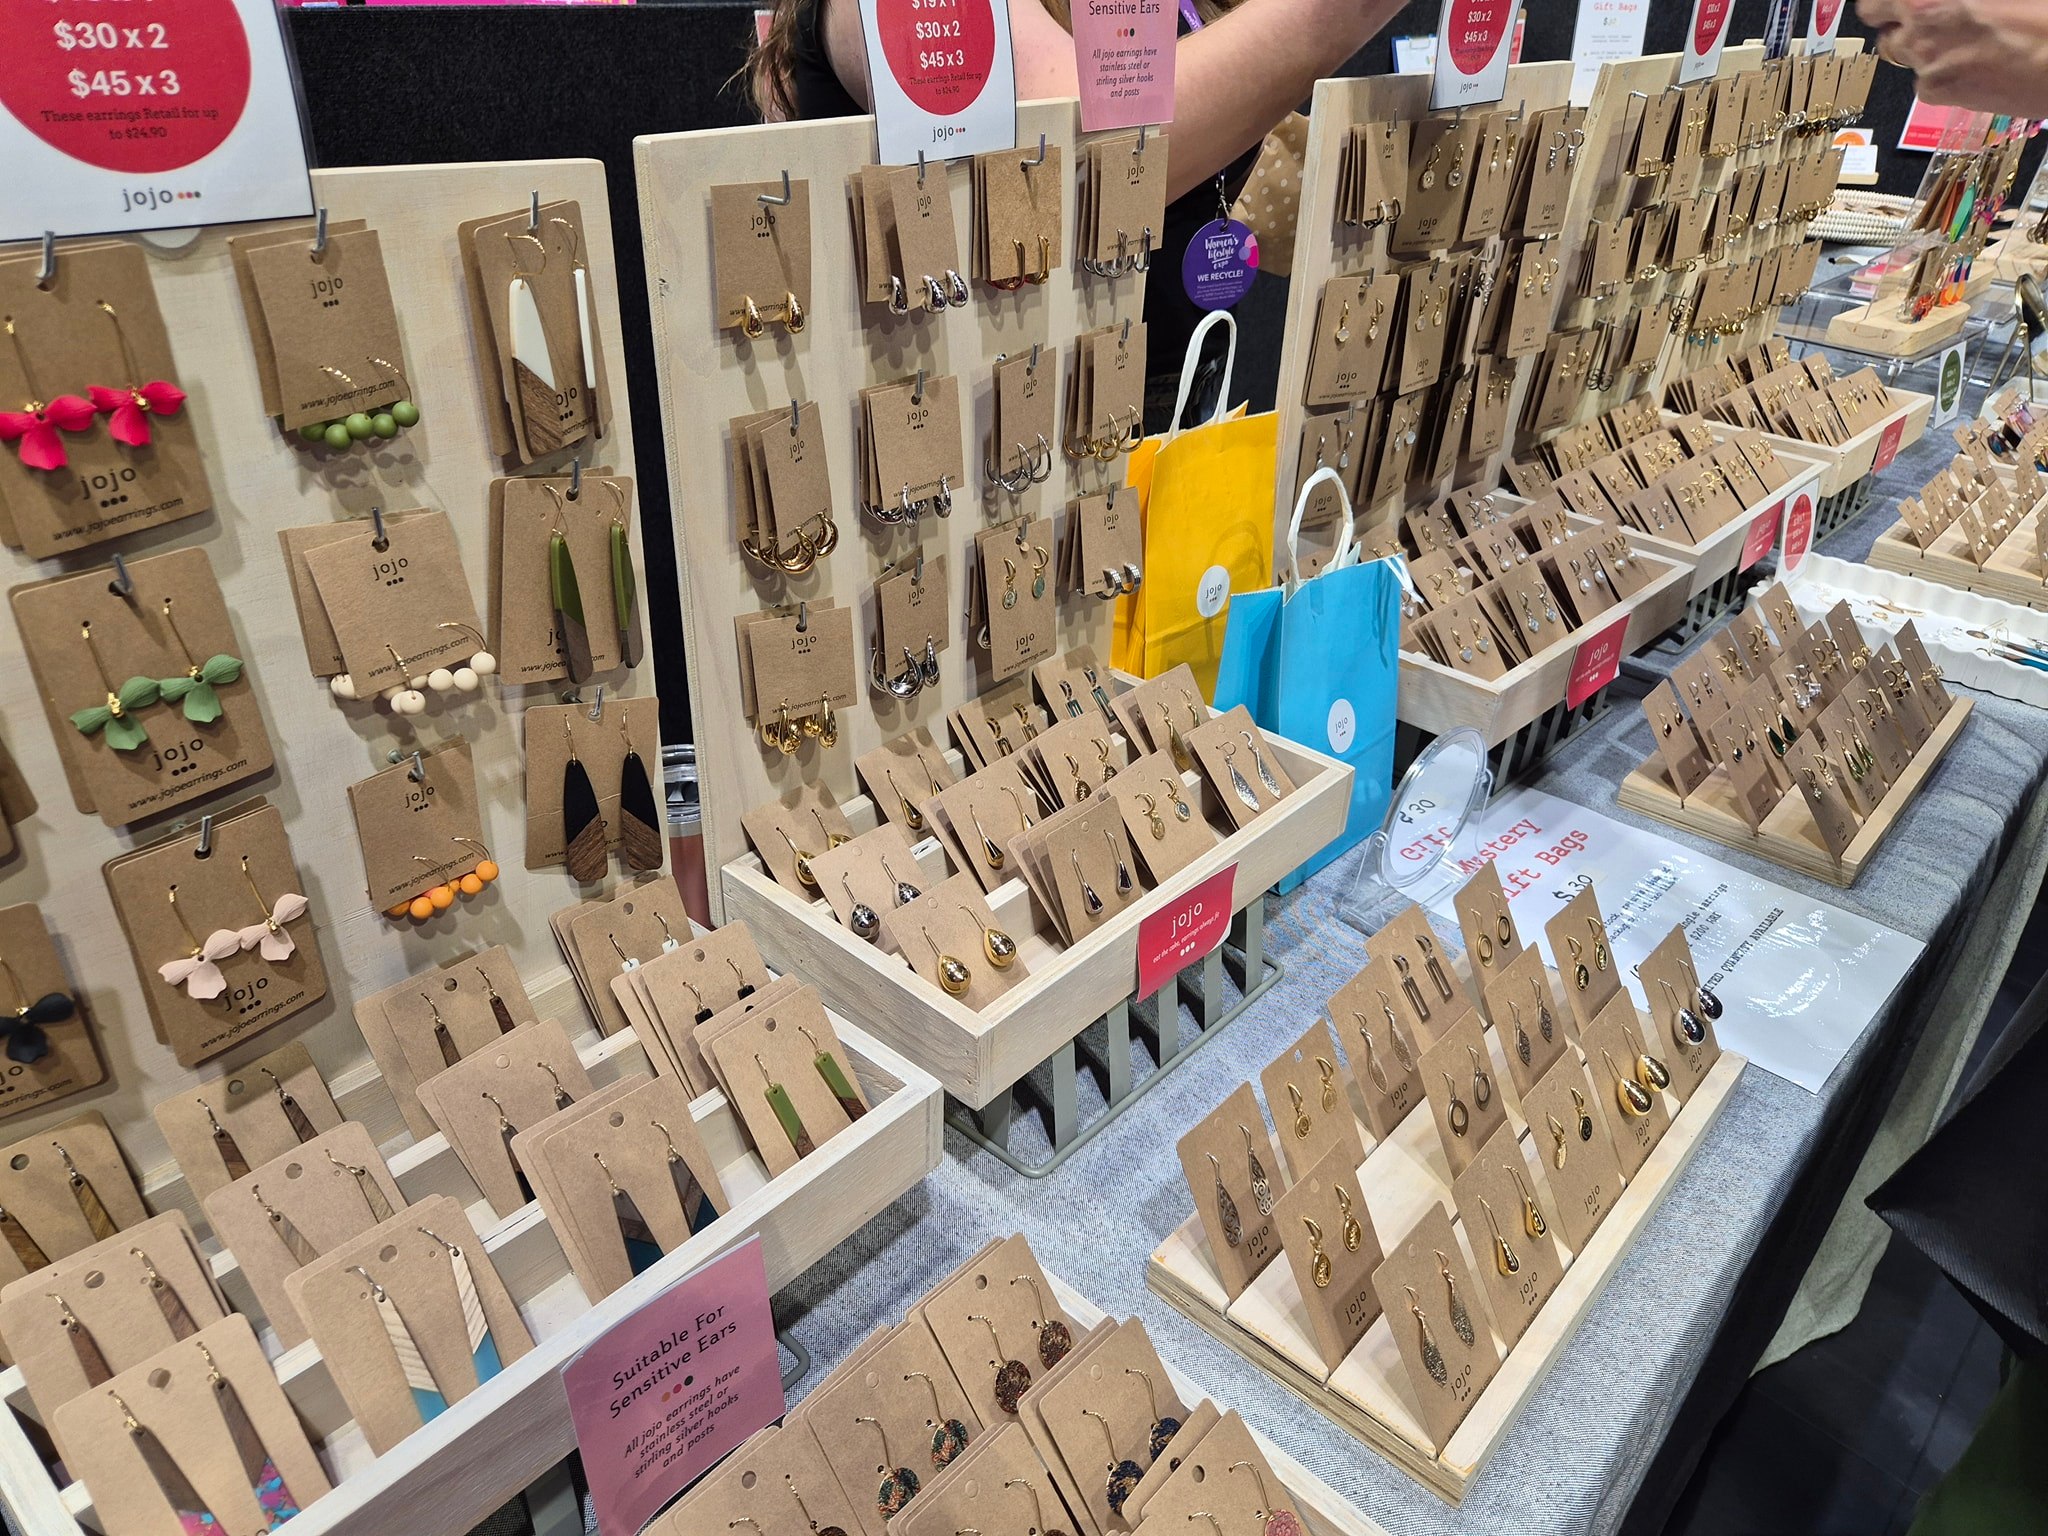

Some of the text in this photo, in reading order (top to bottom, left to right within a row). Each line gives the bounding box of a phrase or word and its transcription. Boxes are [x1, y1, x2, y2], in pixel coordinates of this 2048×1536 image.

[1088, 0, 1160, 15] Sensitive Ears
[1467, 11, 1481, 24] $30
[1486, 10, 1492, 21] 2
[53, 19, 169, 50] $30 x 2
[915, 20, 961, 40] $30 x 2
[1463, 31, 1477, 44] $45
[1482, 30, 1488, 41] 3
[919, 49, 964, 70] $45 x 3
[1092, 46, 1158, 61] All jojo earrings have
[1099, 60, 1150, 72] stainless steel or
[67, 68, 181, 99] $45 x 3
[1095, 71, 1154, 87] stirling silver hooks
[1459, 82, 1473, 94] jojo
[1110, 88, 1140, 99] and posts
[41, 108, 219, 122] These earrings Retail for up
[109, 127, 167, 140] to $24.90
[932, 125, 954, 142] jojo
[1127, 165, 1145, 179] jojo
[122, 188, 174, 212] jojo
[916, 195, 932, 211] jojo
[1541, 203, 1556, 215] jojo
[751, 214, 776, 230] jojo
[1418, 218, 1438, 230] jojo
[1204, 234, 1239, 250] Women's
[1212, 260, 1229, 270] expo
[1197, 269, 1244, 283] WE RECYCLE!
[310, 276, 343, 299] jojo
[1115, 352, 1129, 366] jojo
[1415, 358, 1429, 369] jojo
[1022, 378, 1038, 394] jojo
[1336, 371, 1357, 384] jojo
[301, 378, 395, 411] www.jojoearrings.com
[554, 386, 579, 409] ojo
[907, 409, 929, 425] jojo
[789, 440, 805, 458] jojo
[80, 466, 137, 499] jojo
[1313, 495, 1333, 508] jojo
[53, 496, 184, 541] www.jojoearrings.com
[1103, 514, 1119, 527] jojo
[1756, 519, 1772, 539] jojo
[372, 557, 409, 581] jojo
[908, 587, 925, 604] jojo
[1206, 583, 1222, 599] jojo
[791, 635, 817, 649] jojo
[1014, 632, 1035, 651] jojo
[367, 634, 470, 679] www.jojoearrings.com
[1587, 642, 1609, 667] jojo
[1335, 716, 1348, 733] jojo
[152, 738, 204, 771] jojo
[129, 757, 248, 810] www.jojoearrings.com
[405, 786, 435, 808] jojo
[1456, 818, 1543, 877] Mystery
[1534, 828, 1590, 867] Bags
[388, 852, 475, 895] www.jojoearrings.com
[1170, 902, 1203, 939] jojo
[1749, 906, 1785, 942] AVAILABLE
[224, 977, 268, 1011] jojo
[200, 992, 305, 1049] www.jojoearrings.com
[1689, 1047, 1703, 1072] jojo
[1390, 1080, 1408, 1108] jojo
[1635, 1118, 1650, 1144] jojo
[1584, 1185, 1600, 1213] jojo
[1247, 1225, 1269, 1256] jojo
[1519, 1271, 1538, 1304] jojo
[1344, 1290, 1367, 1325] jojo
[612, 1304, 726, 1391] Suitable For
[609, 1320, 738, 1419] Sensitive Ears
[1450, 1364, 1472, 1401] jojo
[624, 1365, 741, 1458] All jojo earrings have
[639, 1385, 729, 1458] stainless steel or
[634, 1392, 739, 1479] stirling silver hooks
[662, 1423, 716, 1468] and posts
